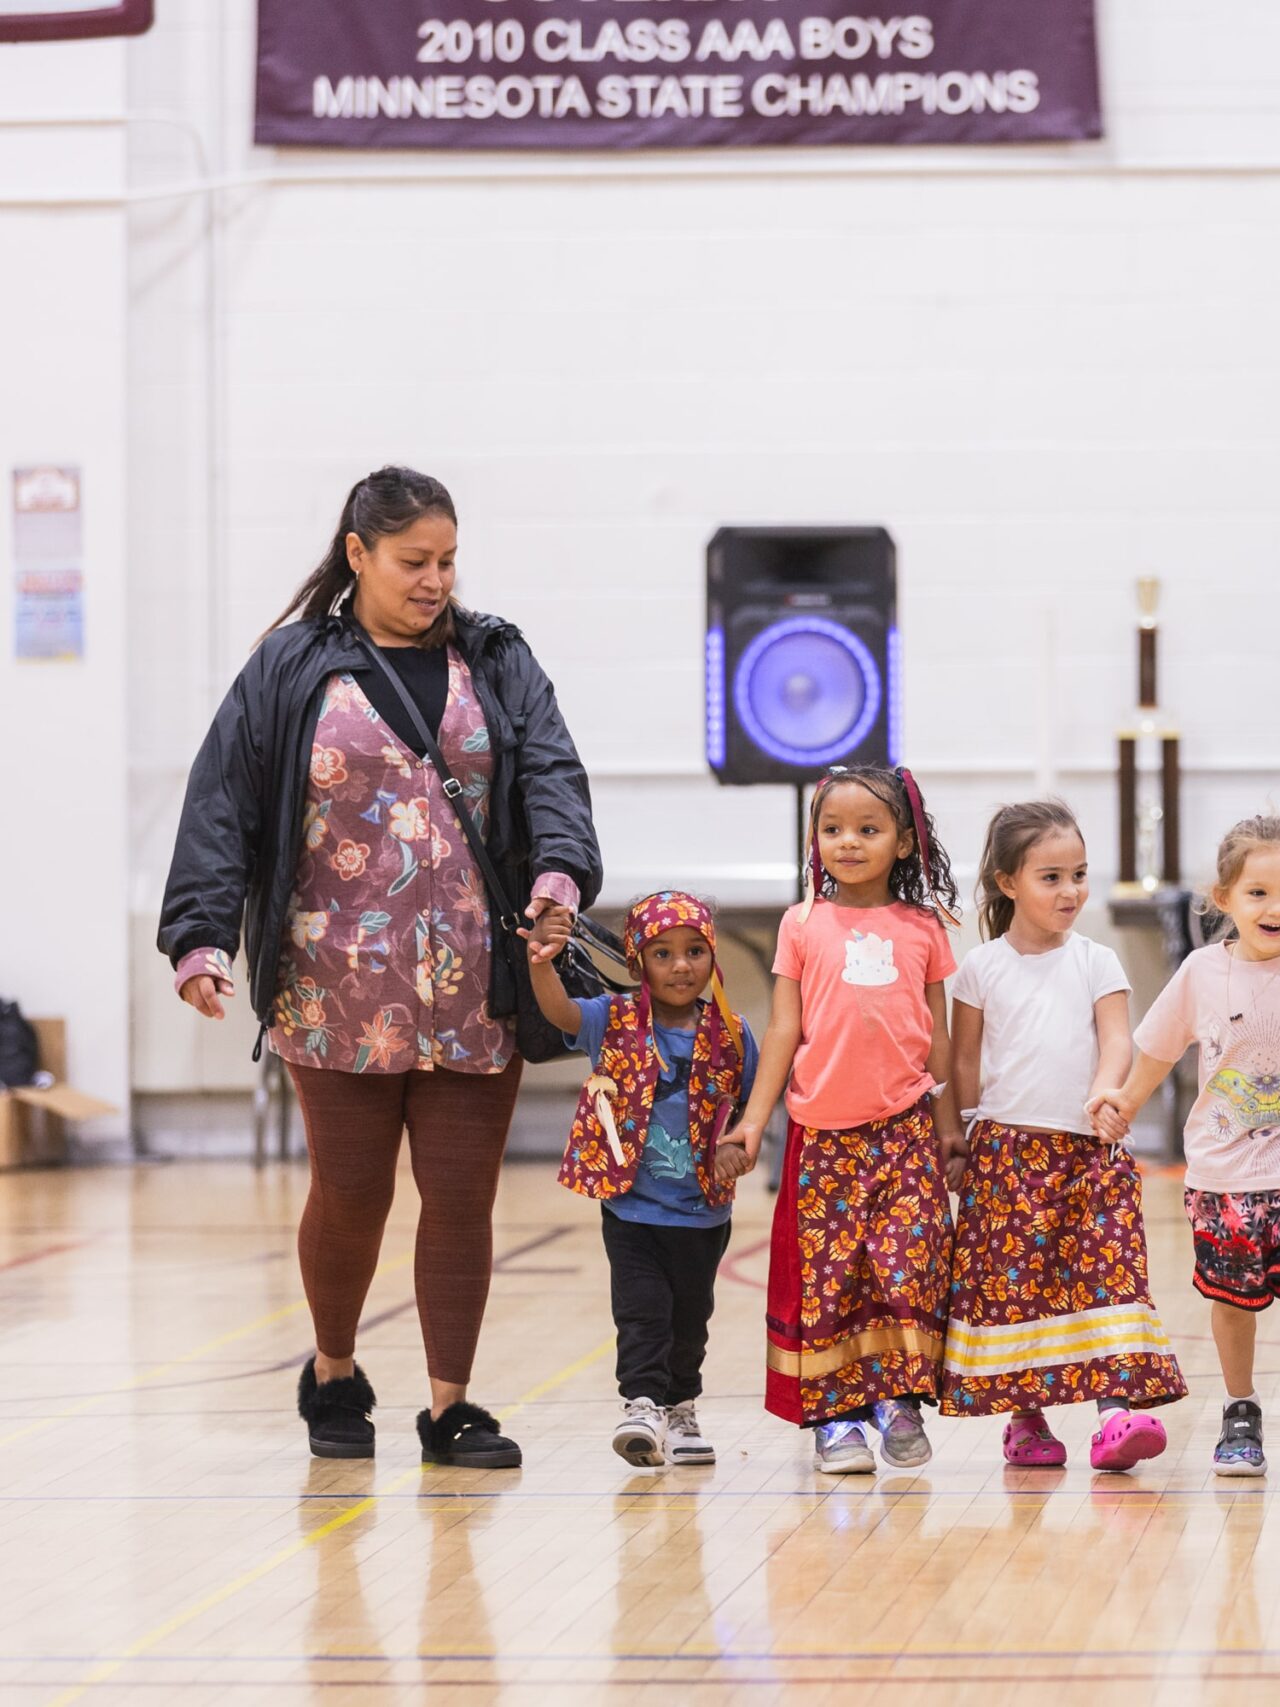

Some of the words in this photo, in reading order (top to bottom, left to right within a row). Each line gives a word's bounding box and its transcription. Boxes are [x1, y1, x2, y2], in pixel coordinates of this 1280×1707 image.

[416, 19, 526, 63] 2010
[533, 19, 691, 62] CLASS
[695, 19, 796, 61] AAA
[798, 16, 935, 60] BOYS
[313, 75, 592, 118] MINNESOTA
[596, 75, 744, 118] STATE
[751, 70, 1041, 116] CHAMPIONS
